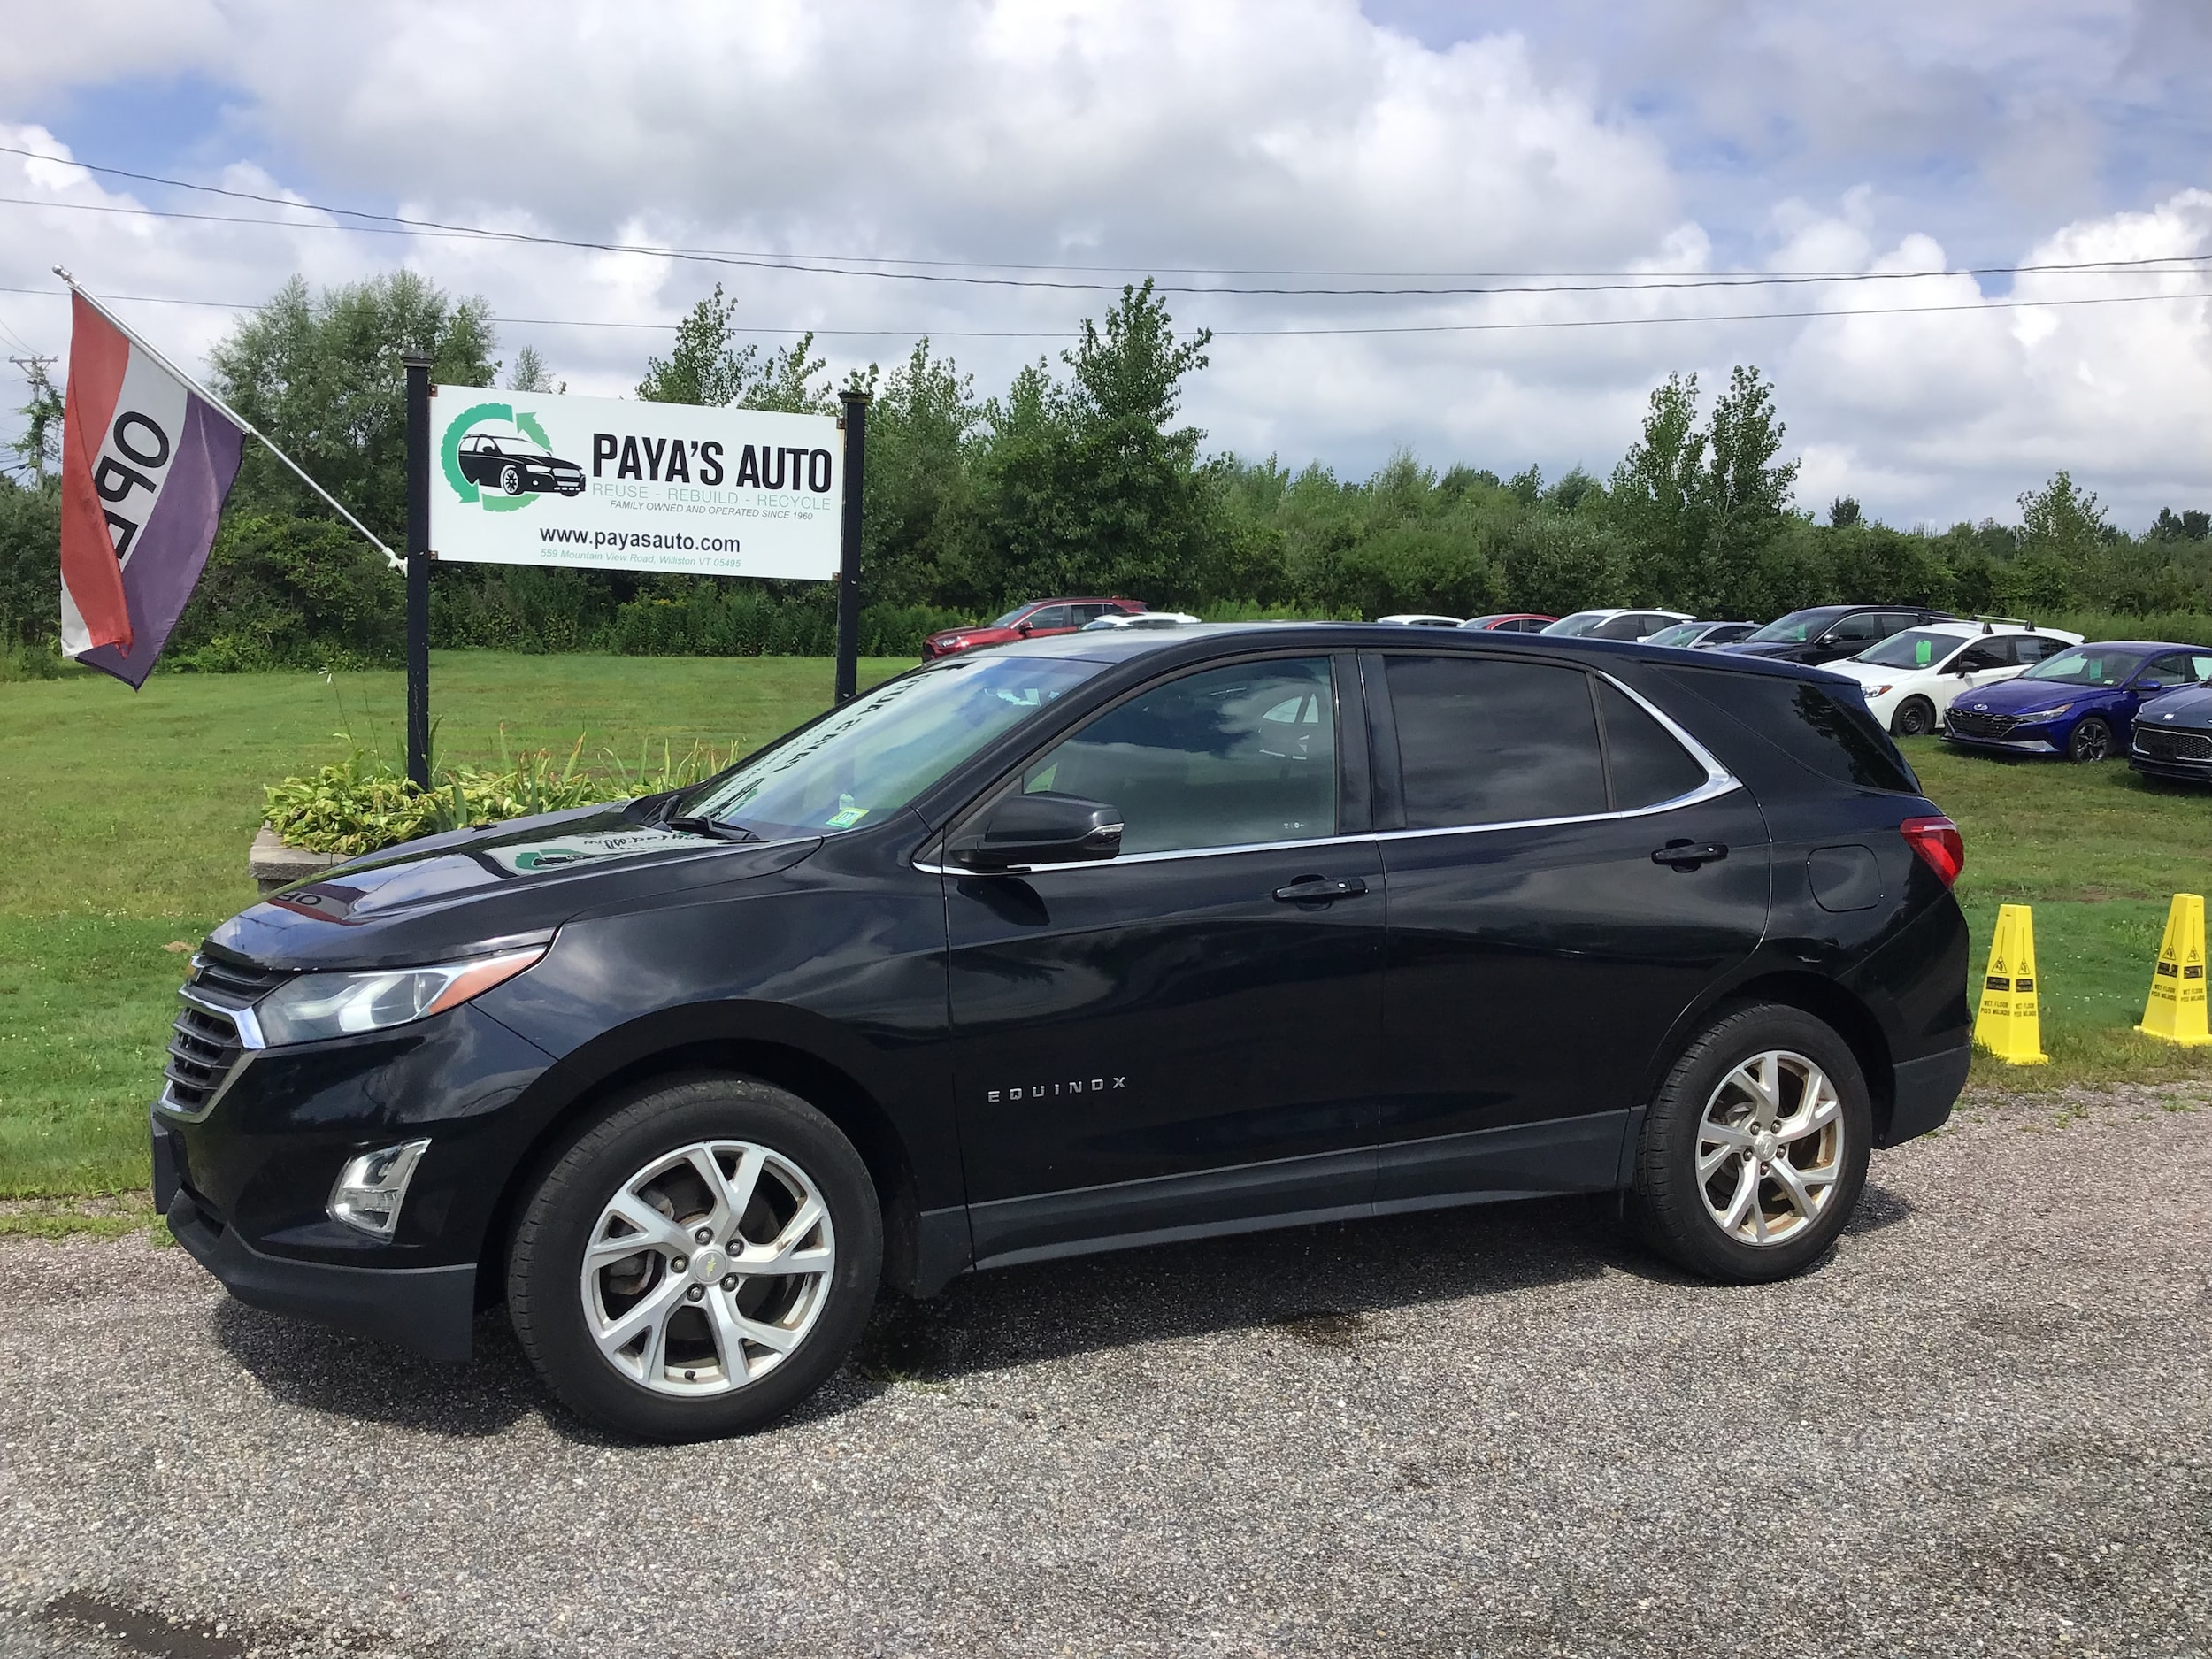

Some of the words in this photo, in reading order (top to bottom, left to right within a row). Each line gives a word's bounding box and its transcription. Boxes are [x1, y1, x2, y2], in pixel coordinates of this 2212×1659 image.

[592, 433, 724, 486] PAYA'S
[736, 444, 833, 493] AUTO
[592, 483, 649, 499] REUSE
[668, 488, 739, 504] REBUILD
[757, 494, 831, 511] RECYCLE
[610, 500, 644, 510] FAMILY
[646, 502, 684, 512] OWNED
[686, 505, 706, 514] AND
[709, 506, 760, 518] OPERATED
[762, 510, 790, 519] SINCE
[793, 511, 813, 520] 1960
[540, 528, 741, 553] www.payasauto.com
[541, 549, 558, 557] 559
[560, 549, 603, 560] Mountain
[606, 553, 627, 562] View
[630, 554, 656, 565] Road,
[660, 556, 695, 565] Williston
[713, 558, 741, 567] 05495
[987, 1077, 1126, 1103] EQUINOX
